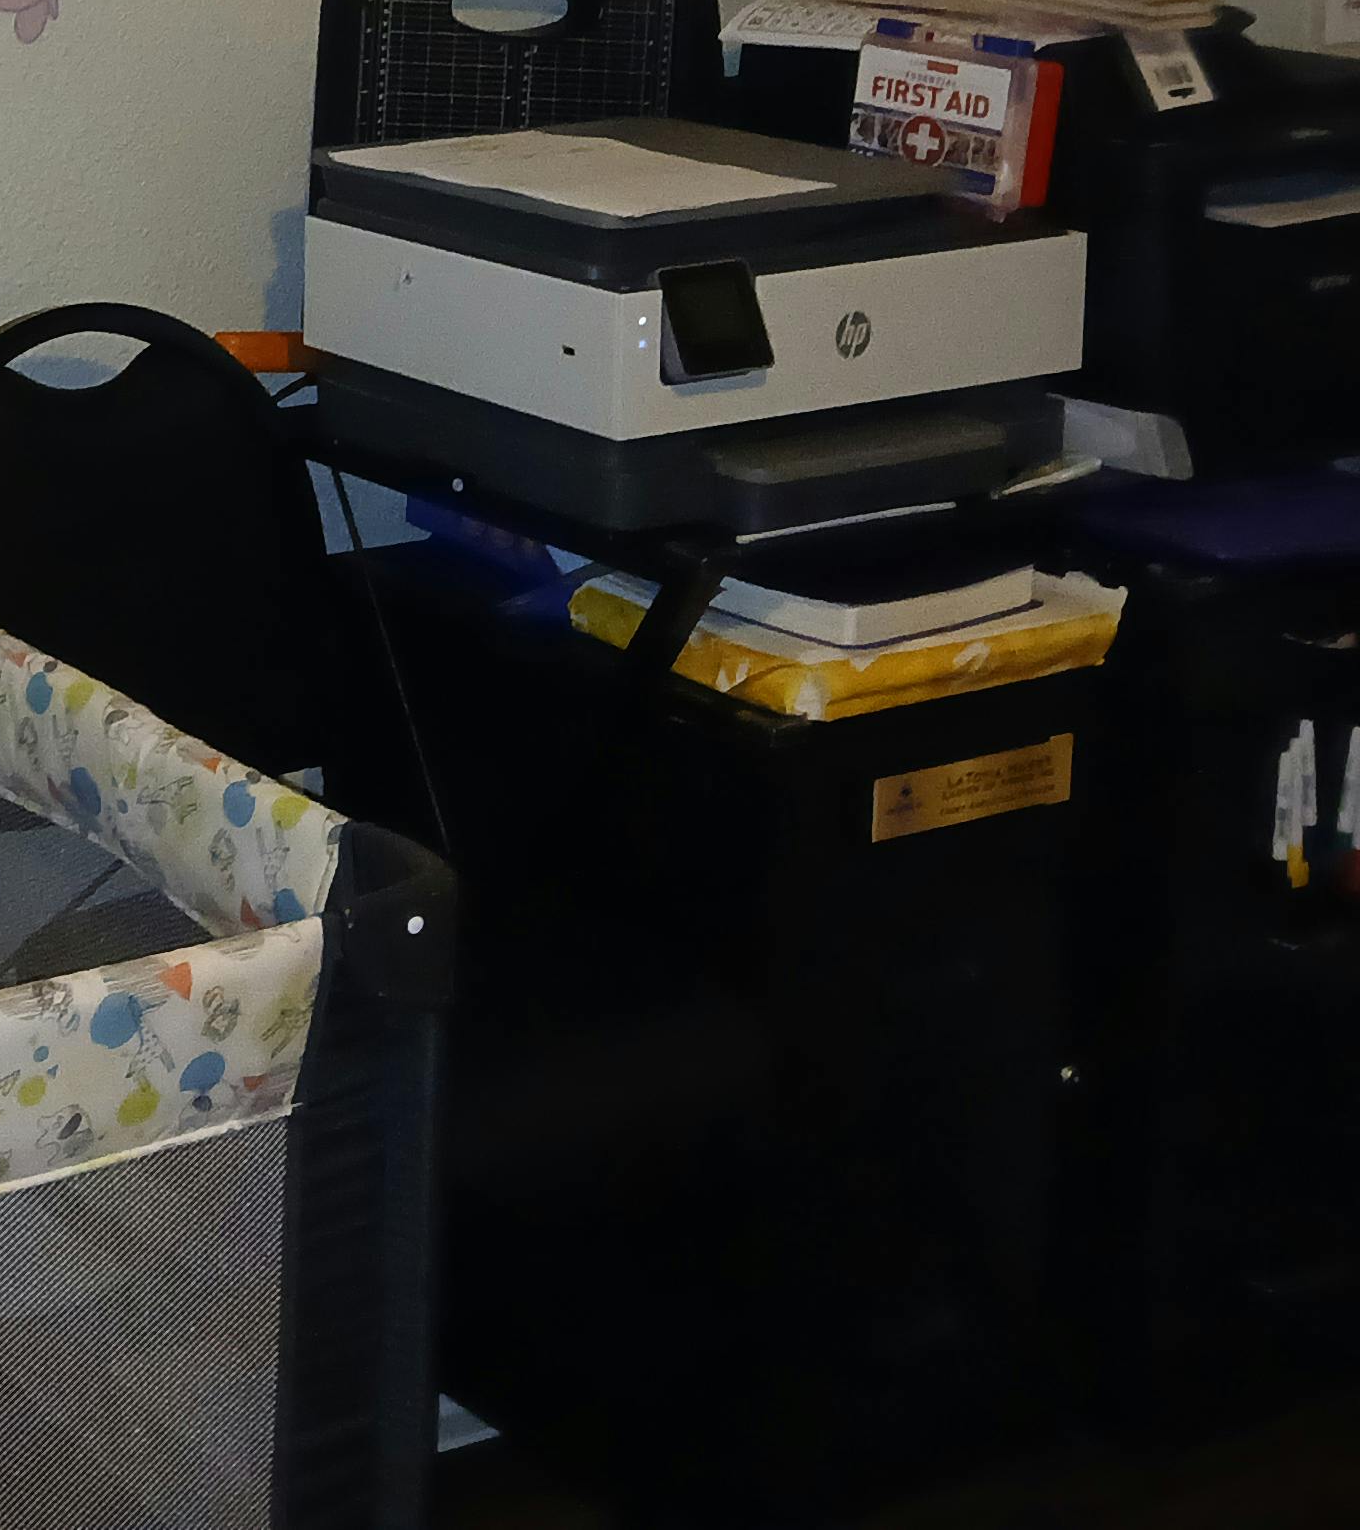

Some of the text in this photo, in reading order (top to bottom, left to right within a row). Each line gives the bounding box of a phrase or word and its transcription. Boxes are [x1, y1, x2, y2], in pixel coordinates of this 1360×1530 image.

[872, 75, 989, 118] FIRST AID
[841, 314, 867, 358] hp
